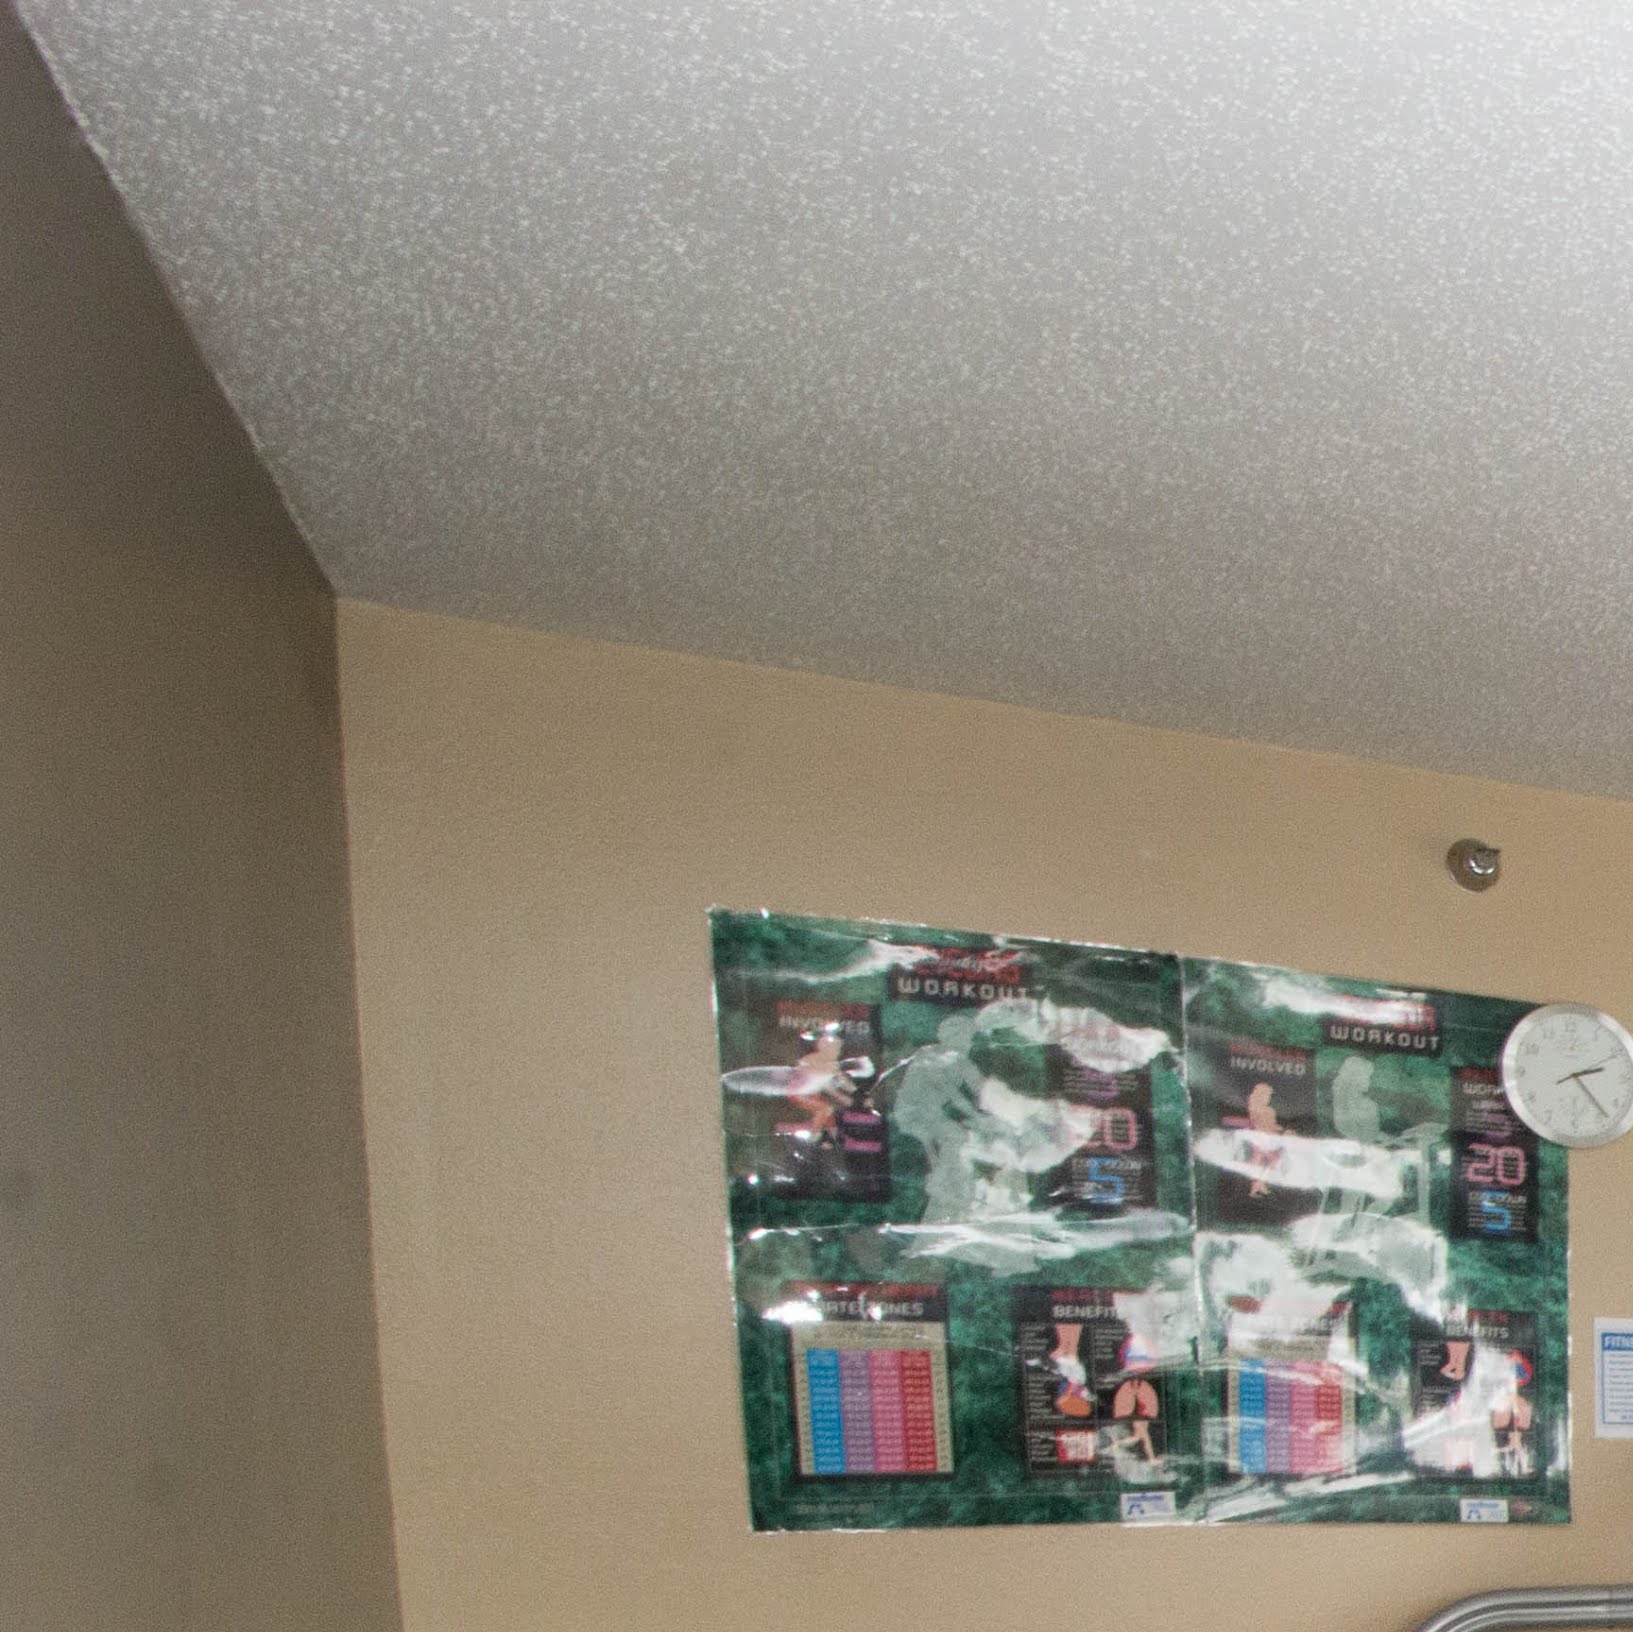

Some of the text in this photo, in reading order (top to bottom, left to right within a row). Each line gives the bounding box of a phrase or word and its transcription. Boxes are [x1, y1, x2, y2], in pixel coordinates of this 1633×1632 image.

[897, 975, 1027, 1000] WORKOUT
[1329, 1025, 1440, 1051] WORKOUT
[1230, 1056, 1307, 1077] INVOLVED
[1466, 1142, 1527, 1186] 20
[1481, 1189, 1512, 1234] 5
